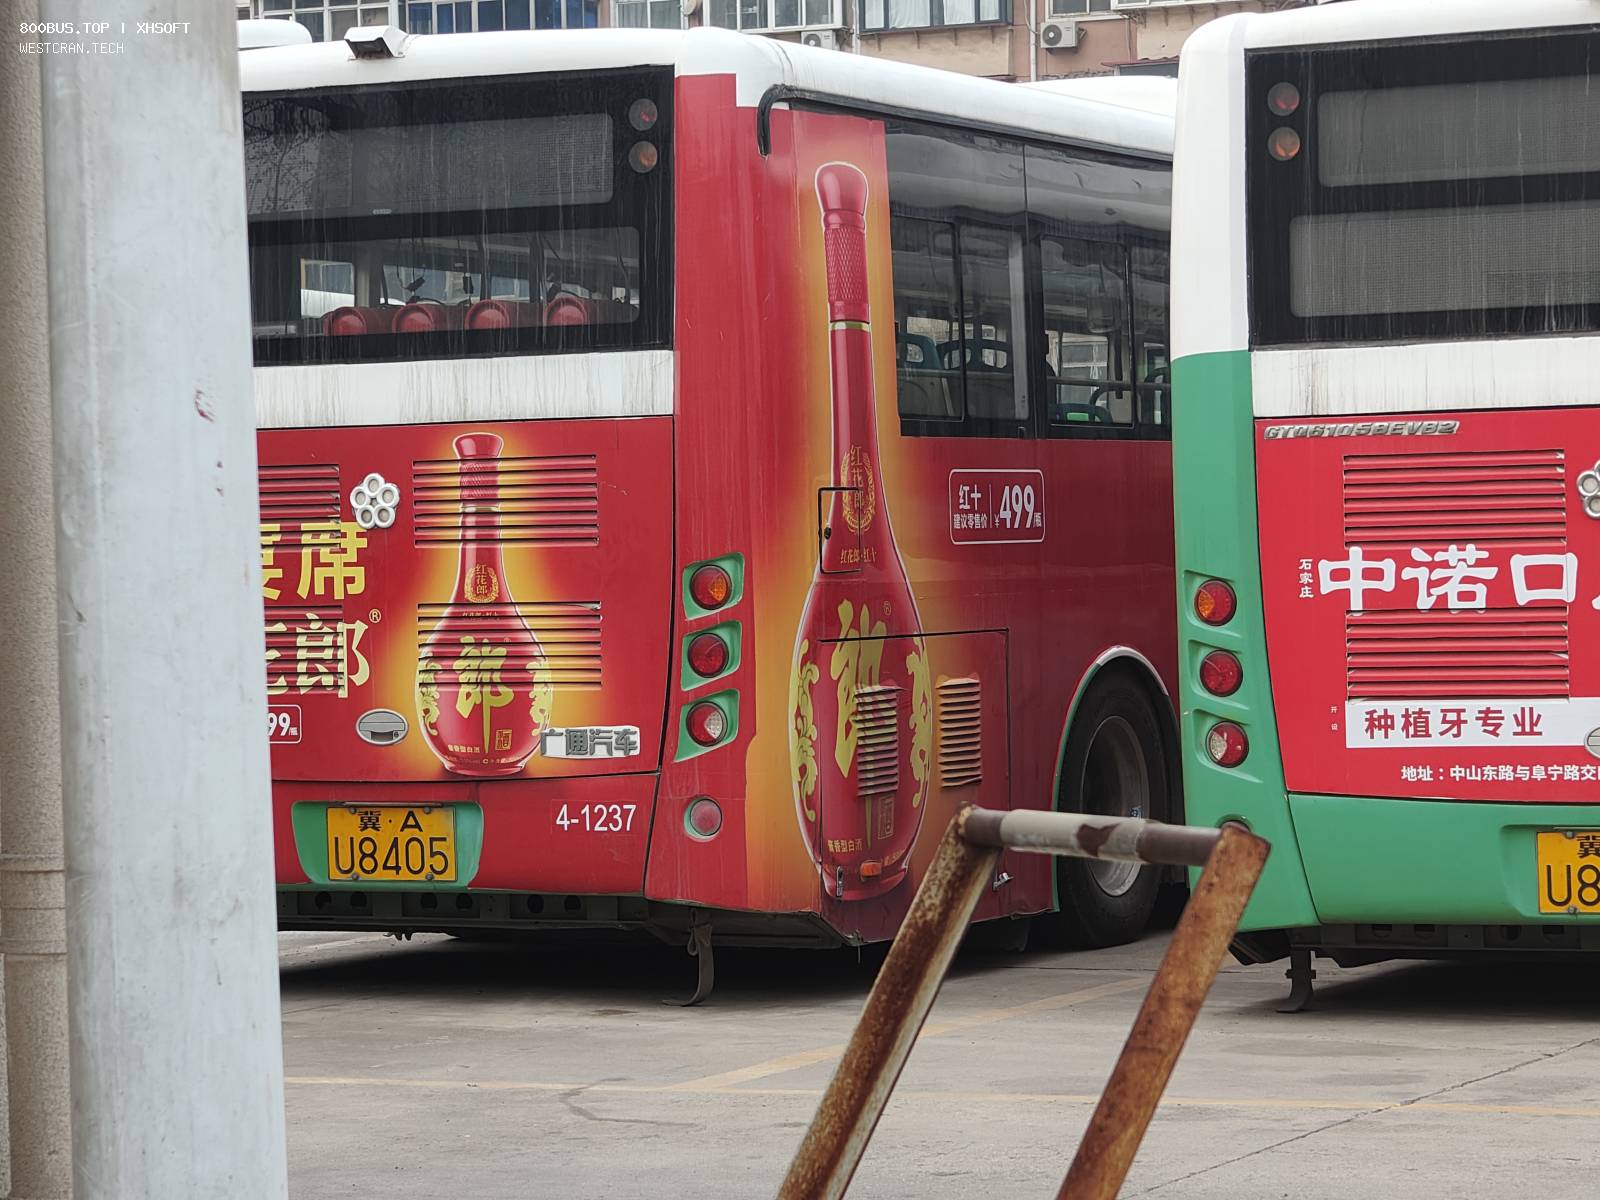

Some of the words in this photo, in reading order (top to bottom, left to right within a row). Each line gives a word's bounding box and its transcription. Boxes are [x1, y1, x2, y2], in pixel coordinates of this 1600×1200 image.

[958, 484, 982, 511] 红十
[1299, 558, 1314, 599] 石家庄
[1317, 543, 1600, 614] 中诺口
[1364, 706, 1543, 740] 种植牙专业
[540, 728, 638, 756] 广通汽车
[1401, 765, 1600, 782] 地址：中山东路与阜宁路交
[555, 804, 637, 832] 4-1237
[334, 836, 449, 876] U8405
[1546, 864, 1600, 907] U8
